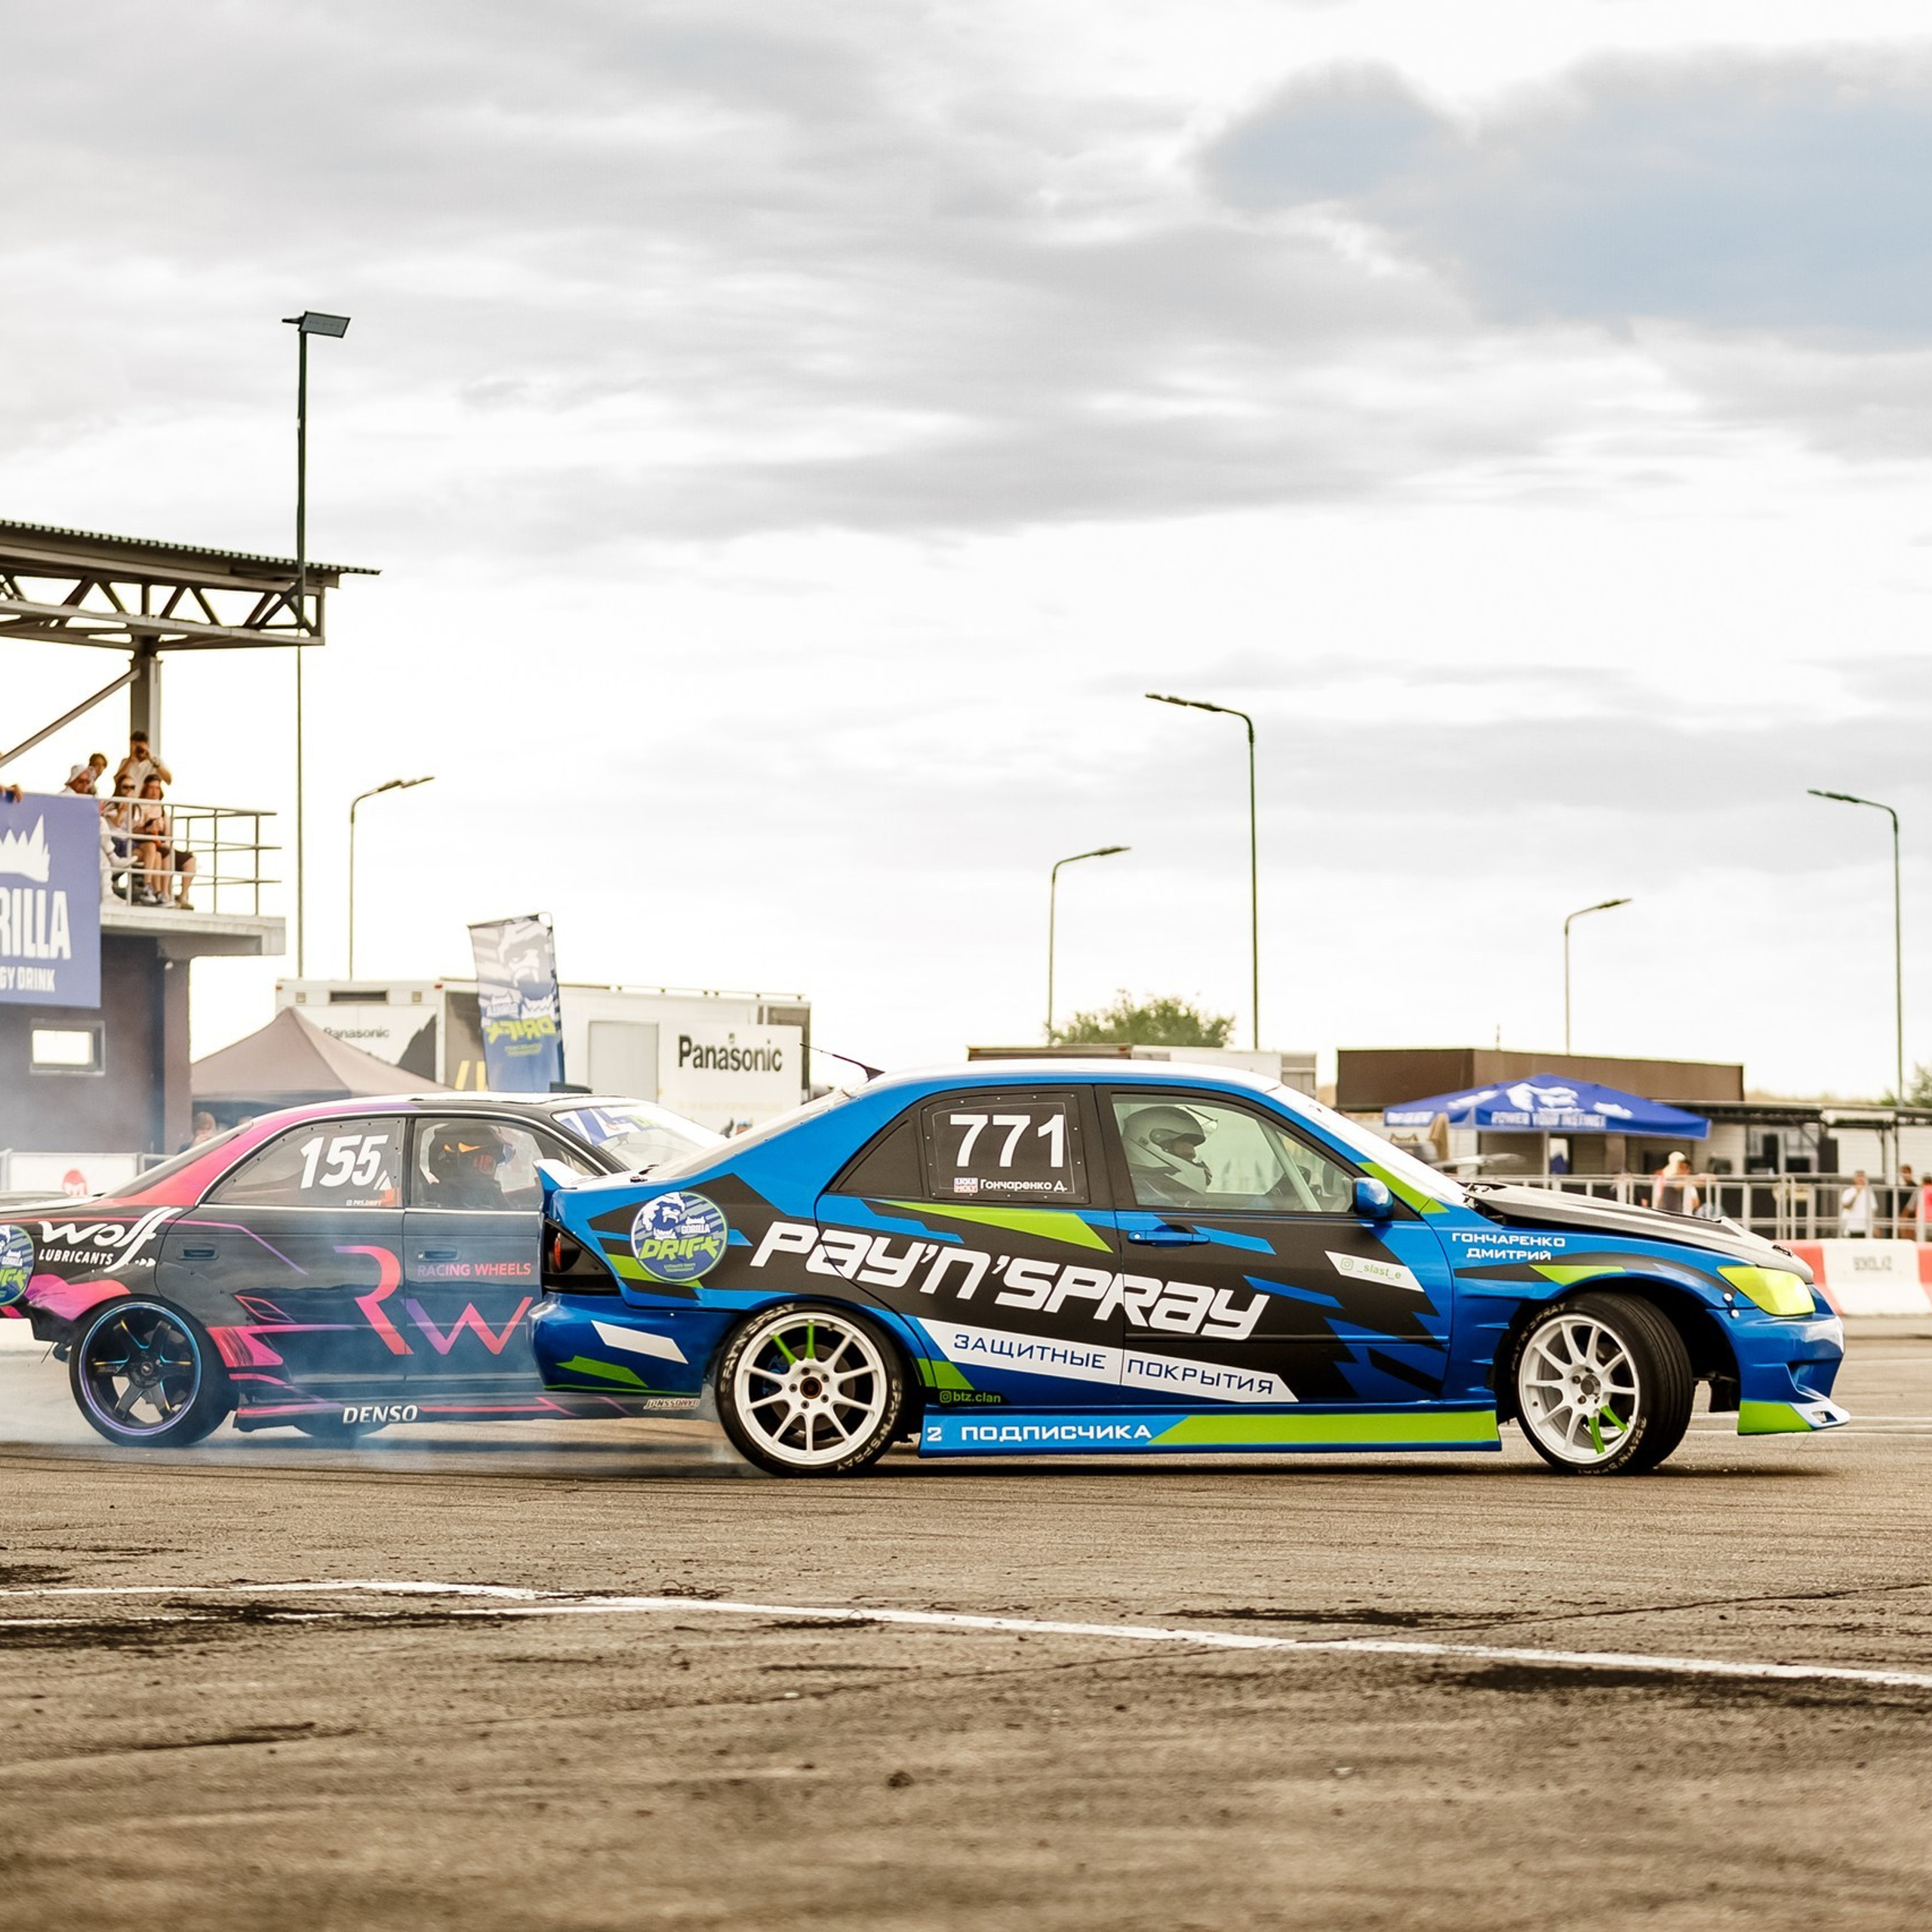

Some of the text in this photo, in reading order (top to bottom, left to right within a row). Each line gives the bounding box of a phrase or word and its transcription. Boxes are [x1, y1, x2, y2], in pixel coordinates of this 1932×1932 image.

[0, 887, 71, 960] RILLA
[17, 966, 55, 992] DRINK
[678, 1035, 783, 1072] Panasonic
[950, 1114, 1065, 1168] 771
[300, 1134, 389, 1189] 155
[980, 1179, 1068, 1192] Гончаренко Д.
[681, 1223, 711, 1235] GORILLA
[638, 1235, 721, 1261] DRIFT
[1451, 1232, 1566, 1247] ГОНЧАРЕНКО
[38, 1248, 114, 1266] LUBRICANTS
[1466, 1247, 1552, 1261] ДМИТРИЙ
[417, 1263, 531, 1277] RACING WHEELS
[953, 1334, 1274, 1395] ЗАЩИТНЫЕ ПОКРЫТИЯ
[953, 1392, 1001, 1403] btz.clan
[342, 1404, 418, 1424] DENSO
[927, 1424, 1153, 1442] 2 ПОДПИСЧИКА
